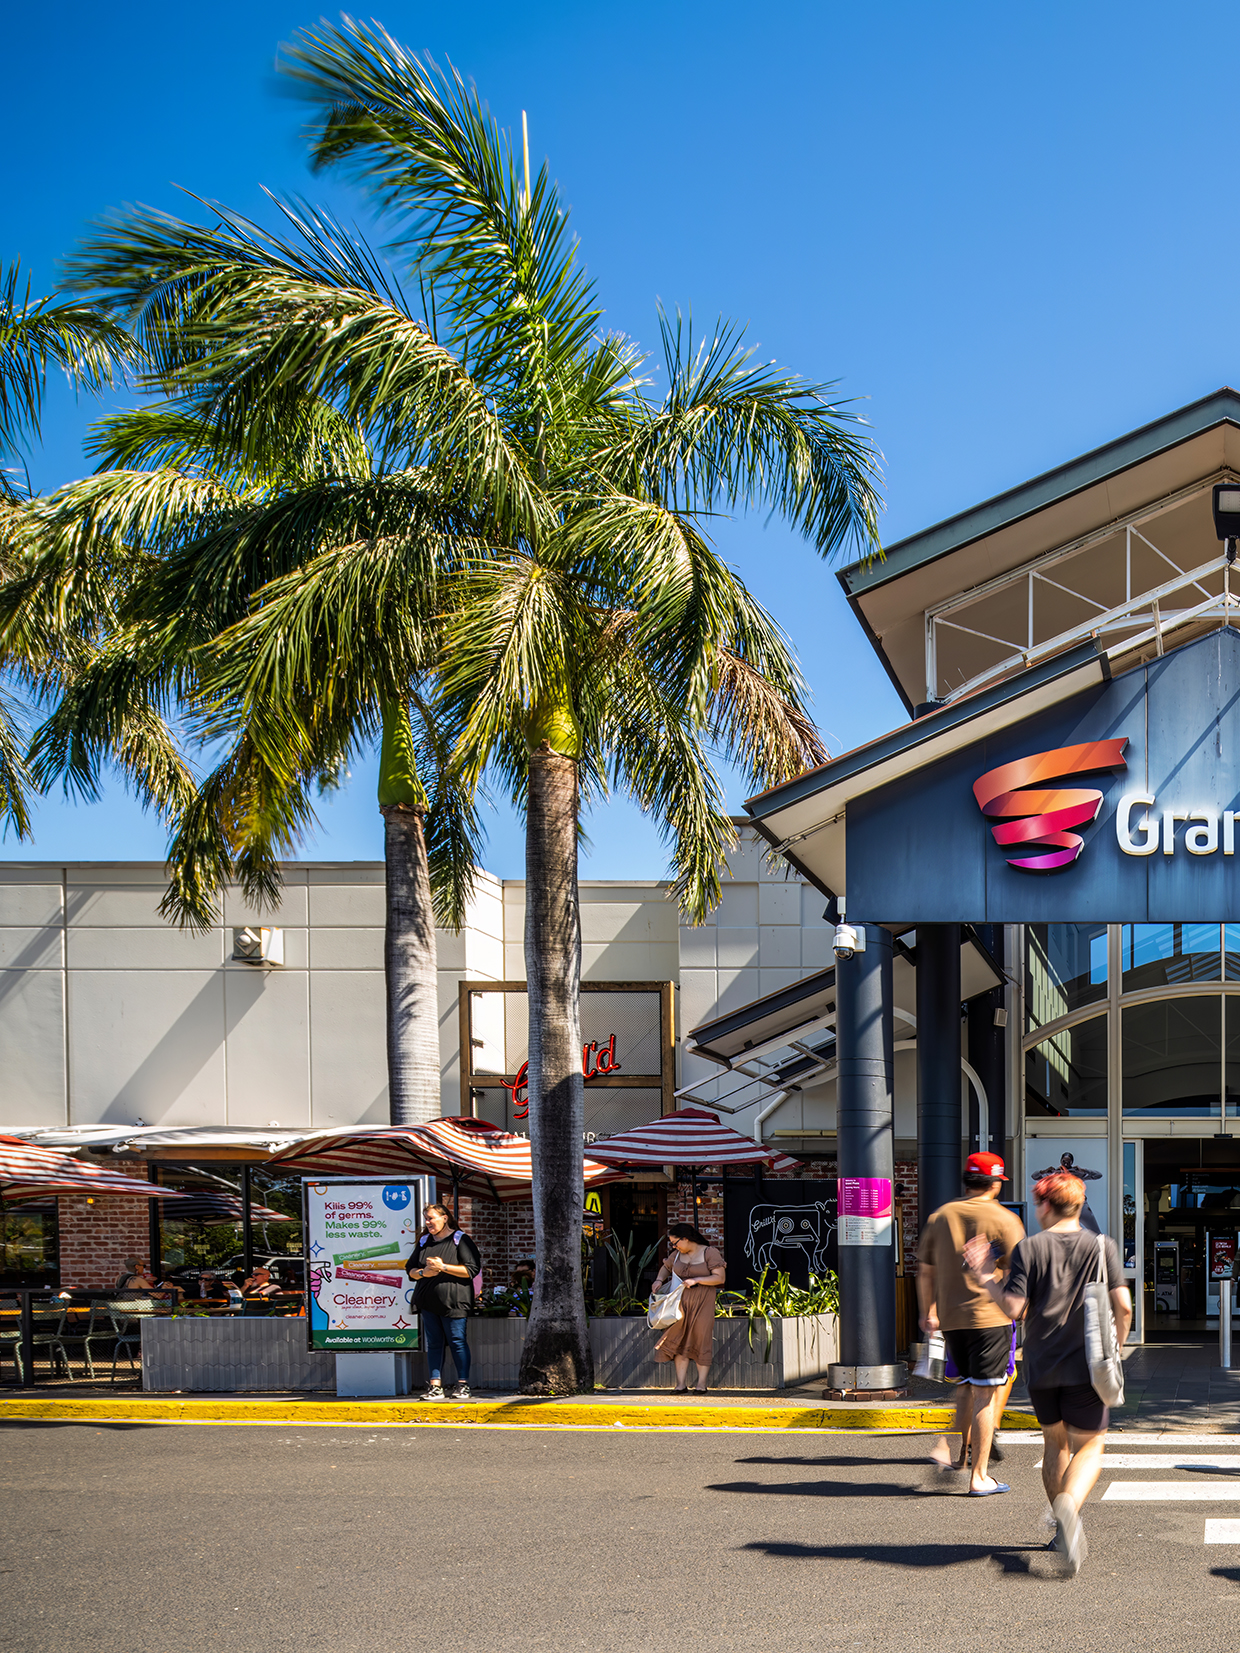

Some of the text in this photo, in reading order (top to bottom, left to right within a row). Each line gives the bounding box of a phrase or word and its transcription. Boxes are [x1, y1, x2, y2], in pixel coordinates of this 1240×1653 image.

[324, 1201, 373, 1210] Kills 99%
[324, 1211, 374, 1220] of germs.
[325, 1220, 387, 1229] Makes 99%
[325, 1230, 383, 1238] less waste.
[324, 1336, 353, 1344] Available
[362, 1335, 395, 1343] woolworths
